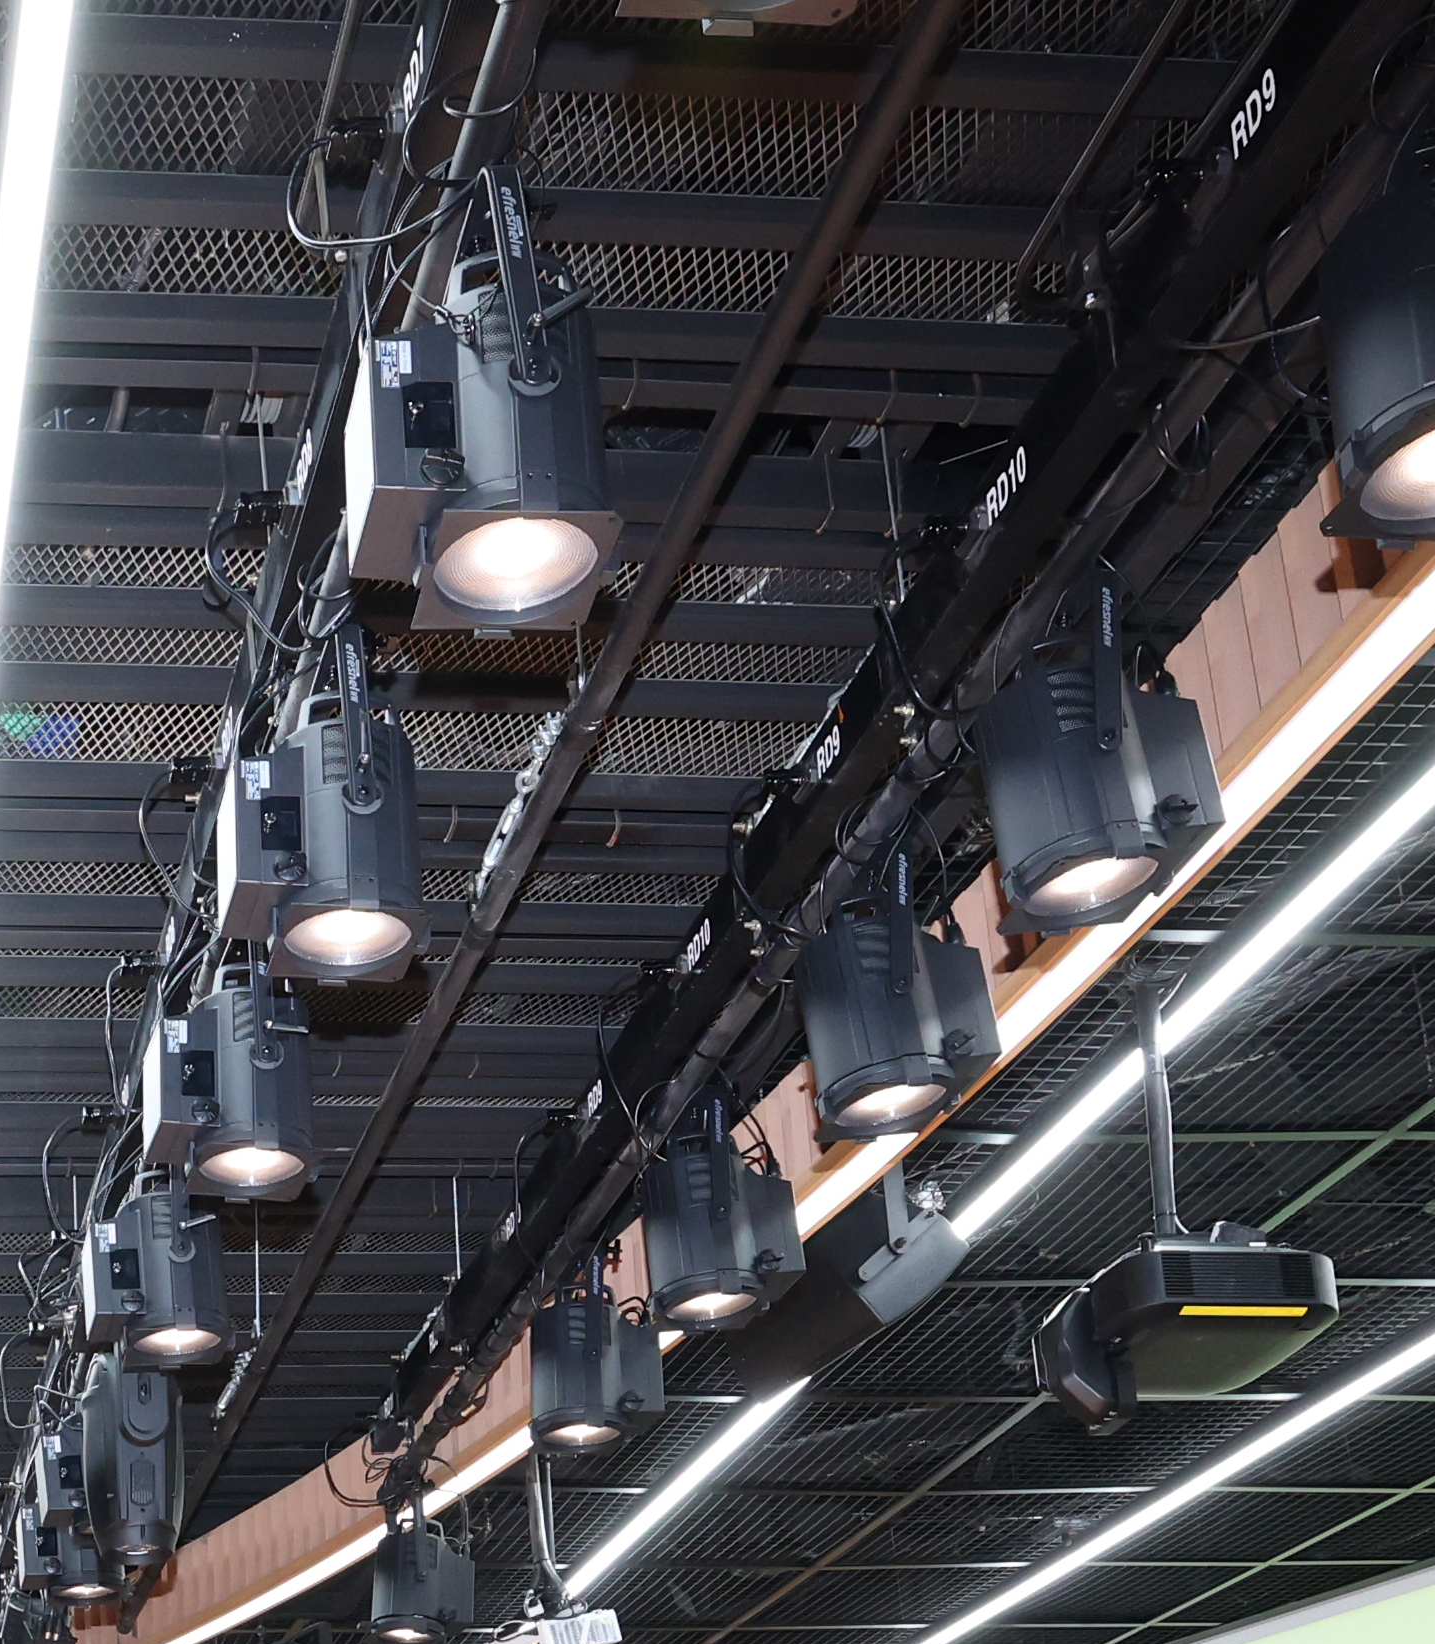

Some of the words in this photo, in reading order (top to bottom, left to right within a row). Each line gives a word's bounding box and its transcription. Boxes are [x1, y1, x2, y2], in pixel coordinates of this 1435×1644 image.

[1230, 68, 1276, 161] RD9
[986, 446, 1027, 528] RD10
[816, 724, 841, 780] RD9
[687, 917, 711, 972] RD10
[587, 1078, 603, 1118] RD9
